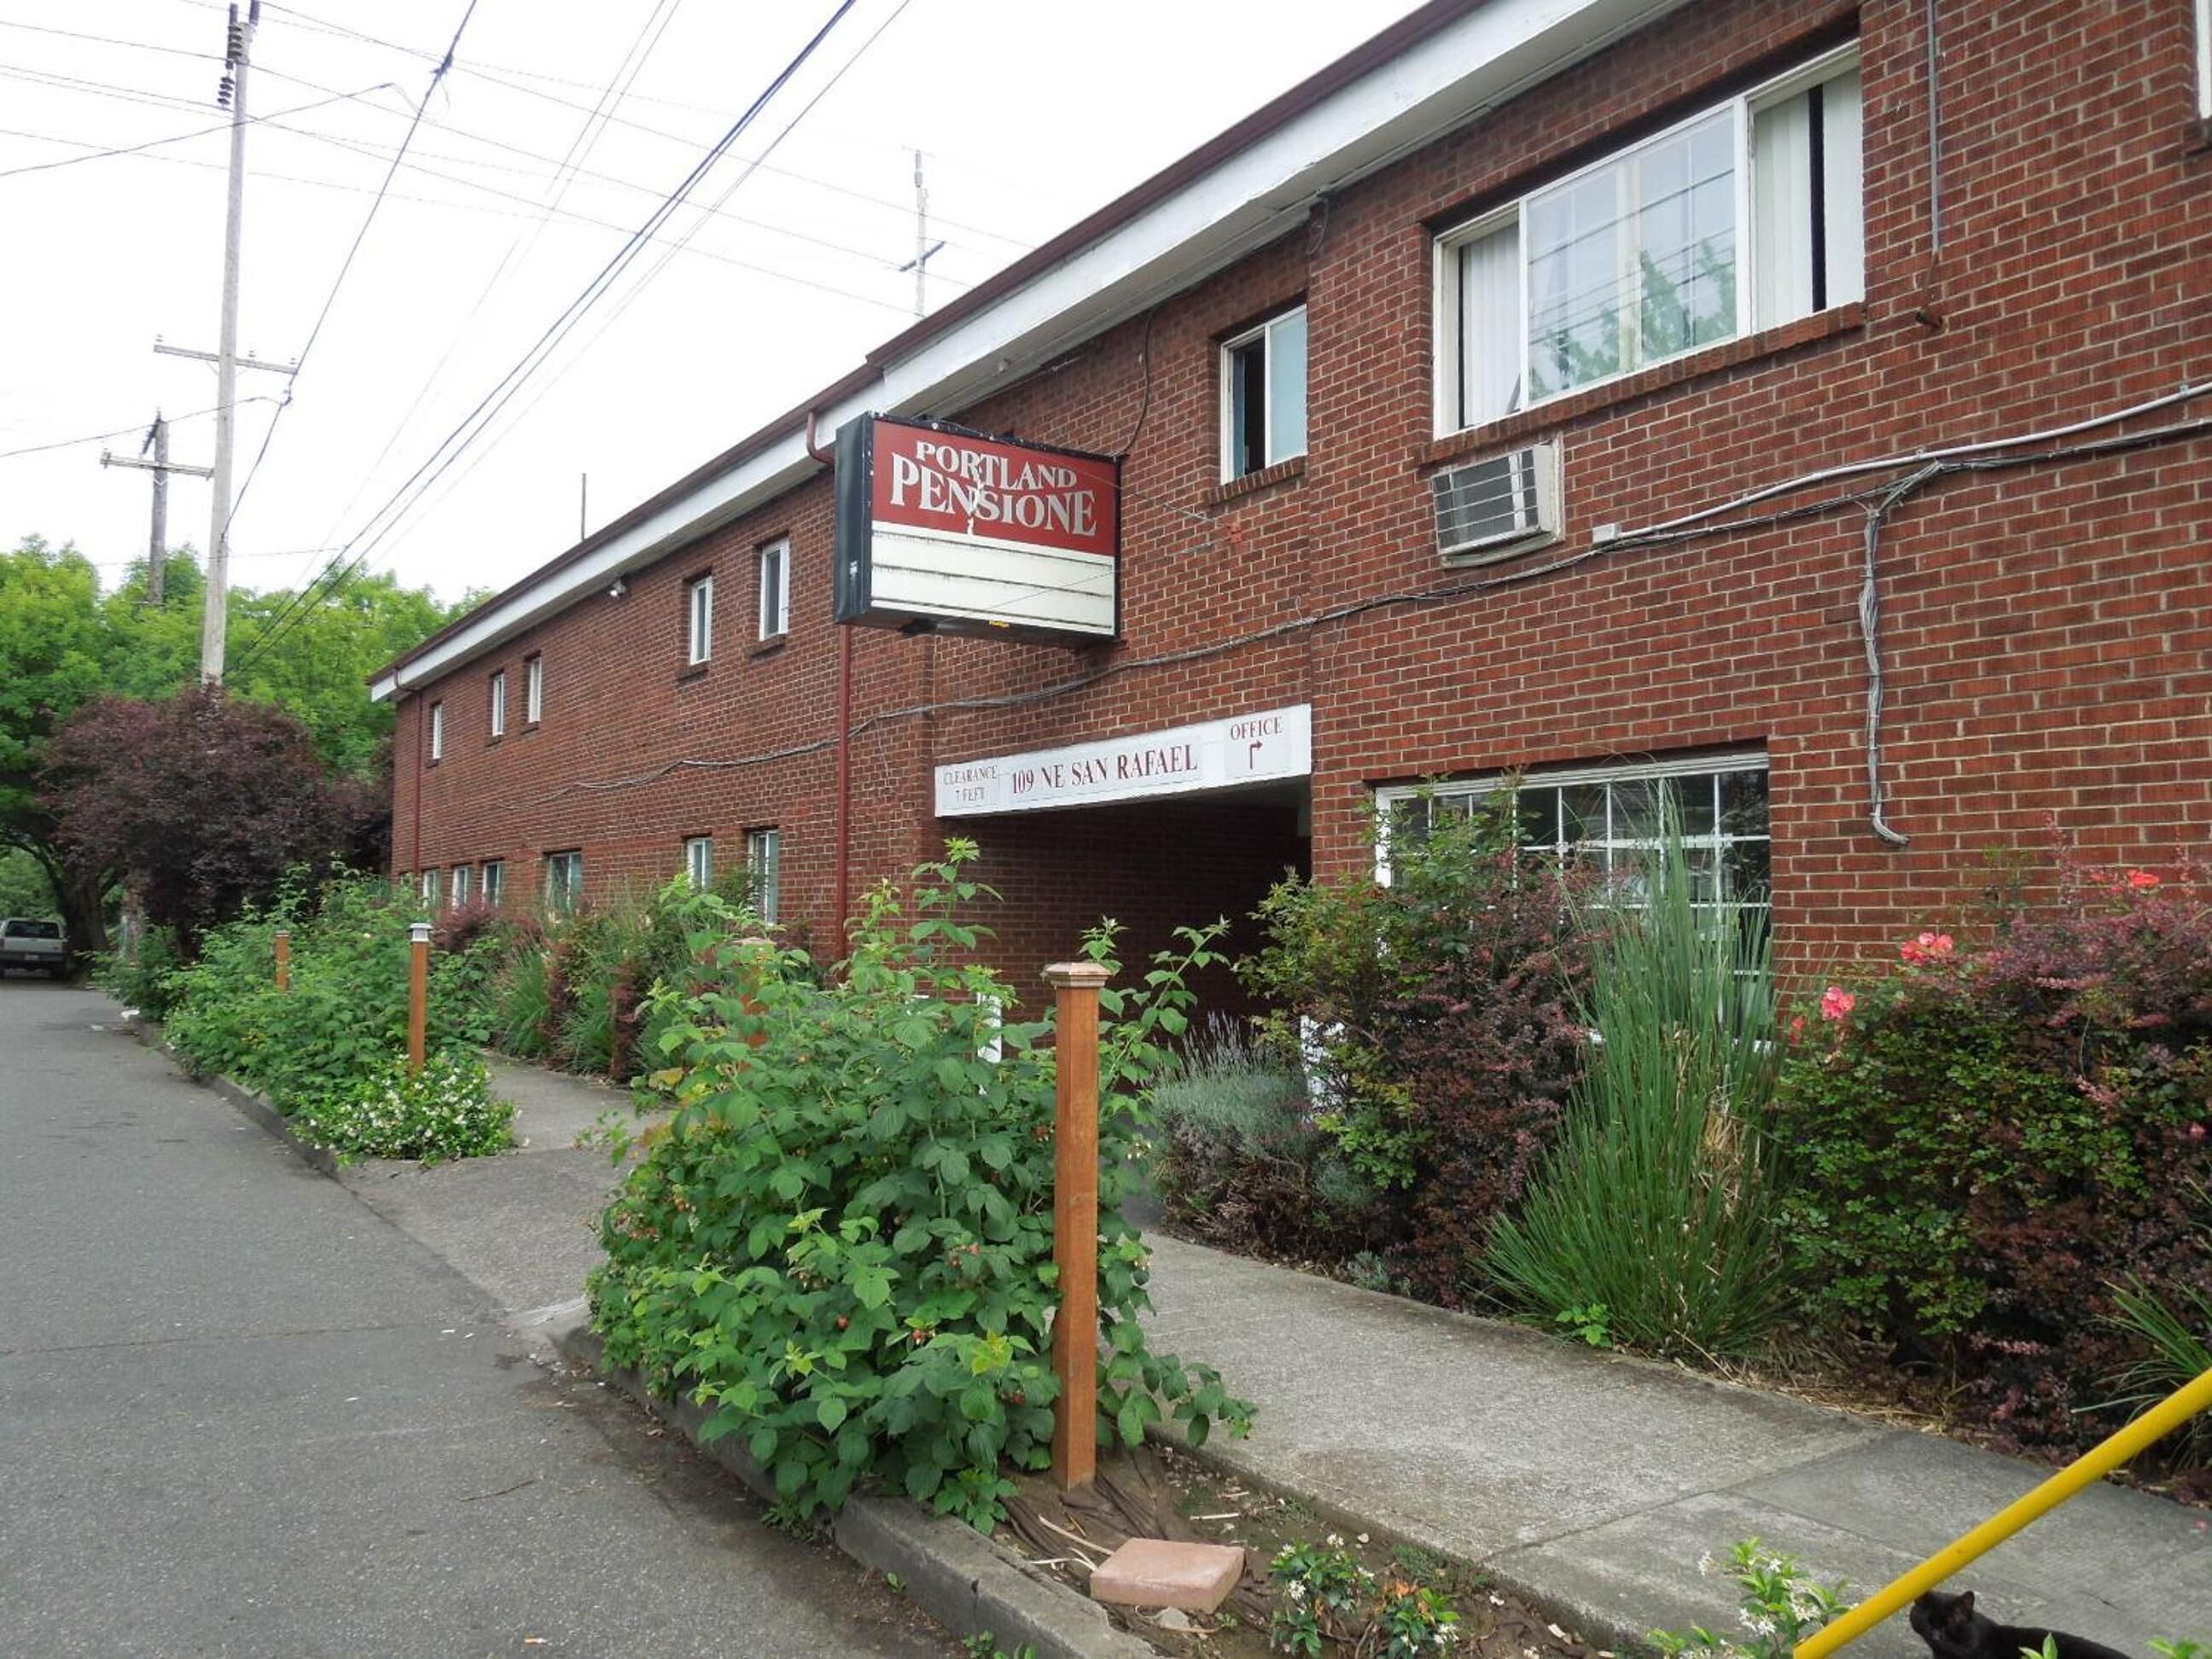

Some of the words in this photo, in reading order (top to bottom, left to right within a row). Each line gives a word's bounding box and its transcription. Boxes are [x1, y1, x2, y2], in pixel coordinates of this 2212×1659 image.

[916, 441, 1078, 491] PORTLAND
[890, 452, 1097, 537] PENSIONE
[1231, 717, 1284, 741] OFFICE
[944, 765, 998, 785] CLEARANCE
[1012, 769, 1034, 794] 109
[1041, 765, 1064, 789] NE
[1072, 758, 1108, 786] SAN
[1117, 744, 1198, 780] RAFAEL
[963, 787, 985, 801] FEET
